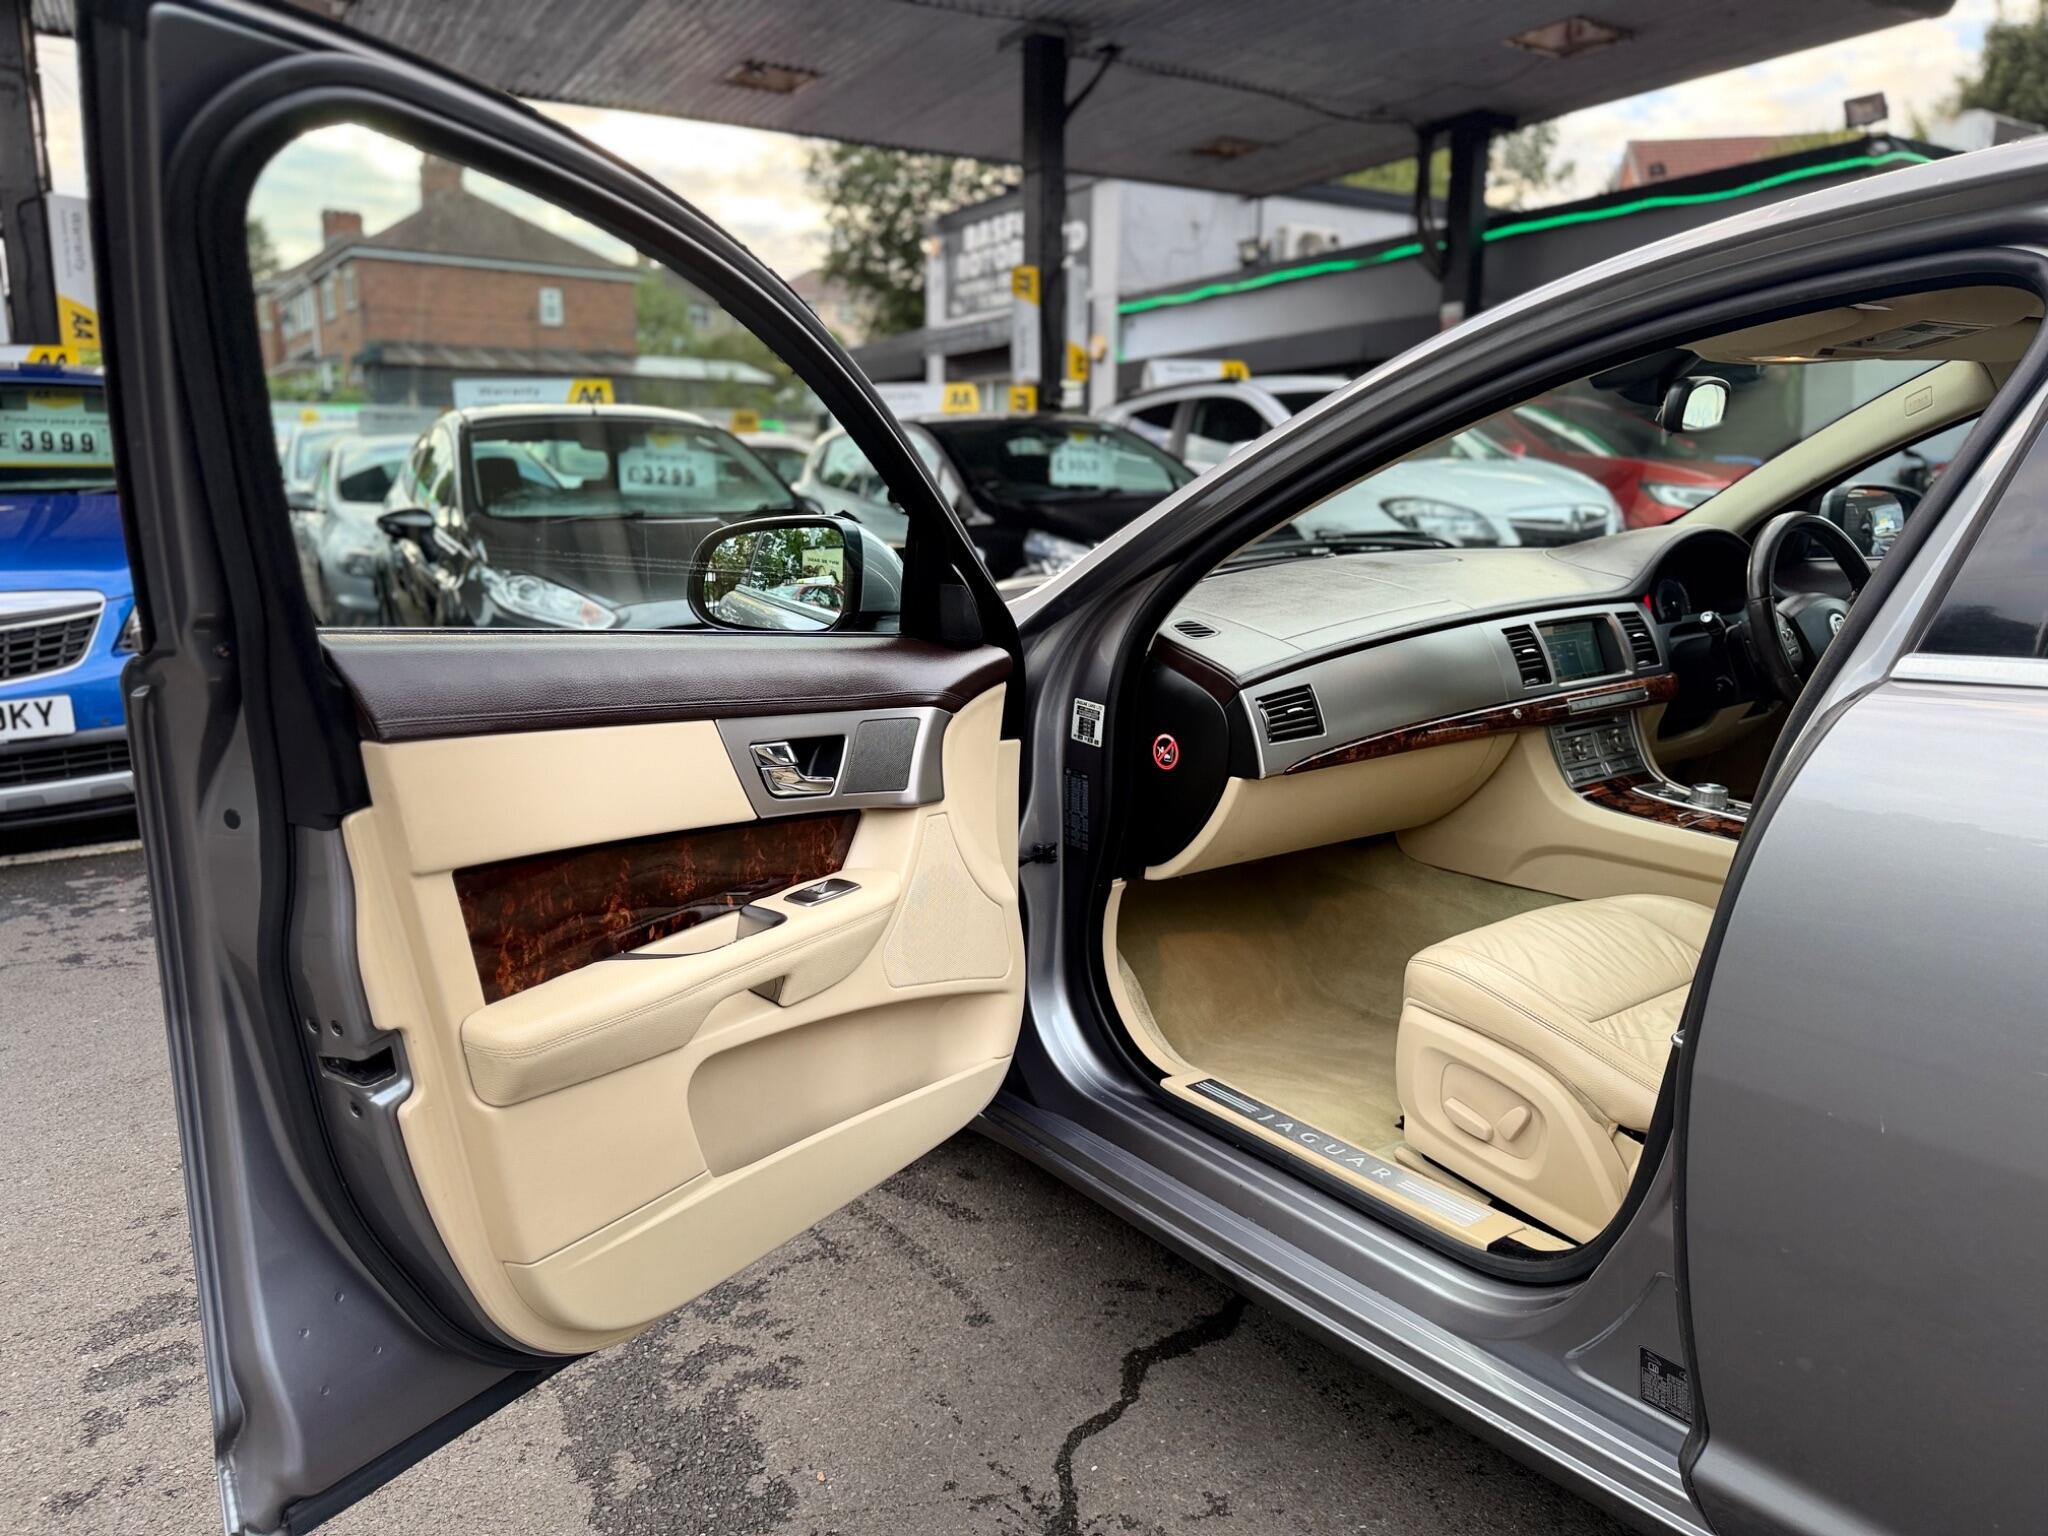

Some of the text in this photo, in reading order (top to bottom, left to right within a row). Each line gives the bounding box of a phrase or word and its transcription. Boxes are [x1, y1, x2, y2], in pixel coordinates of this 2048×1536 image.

[71, 310, 93, 339] AA
[479, 386, 540, 398] Warranty
[1257, 1113, 1393, 1179] JAGUAR
